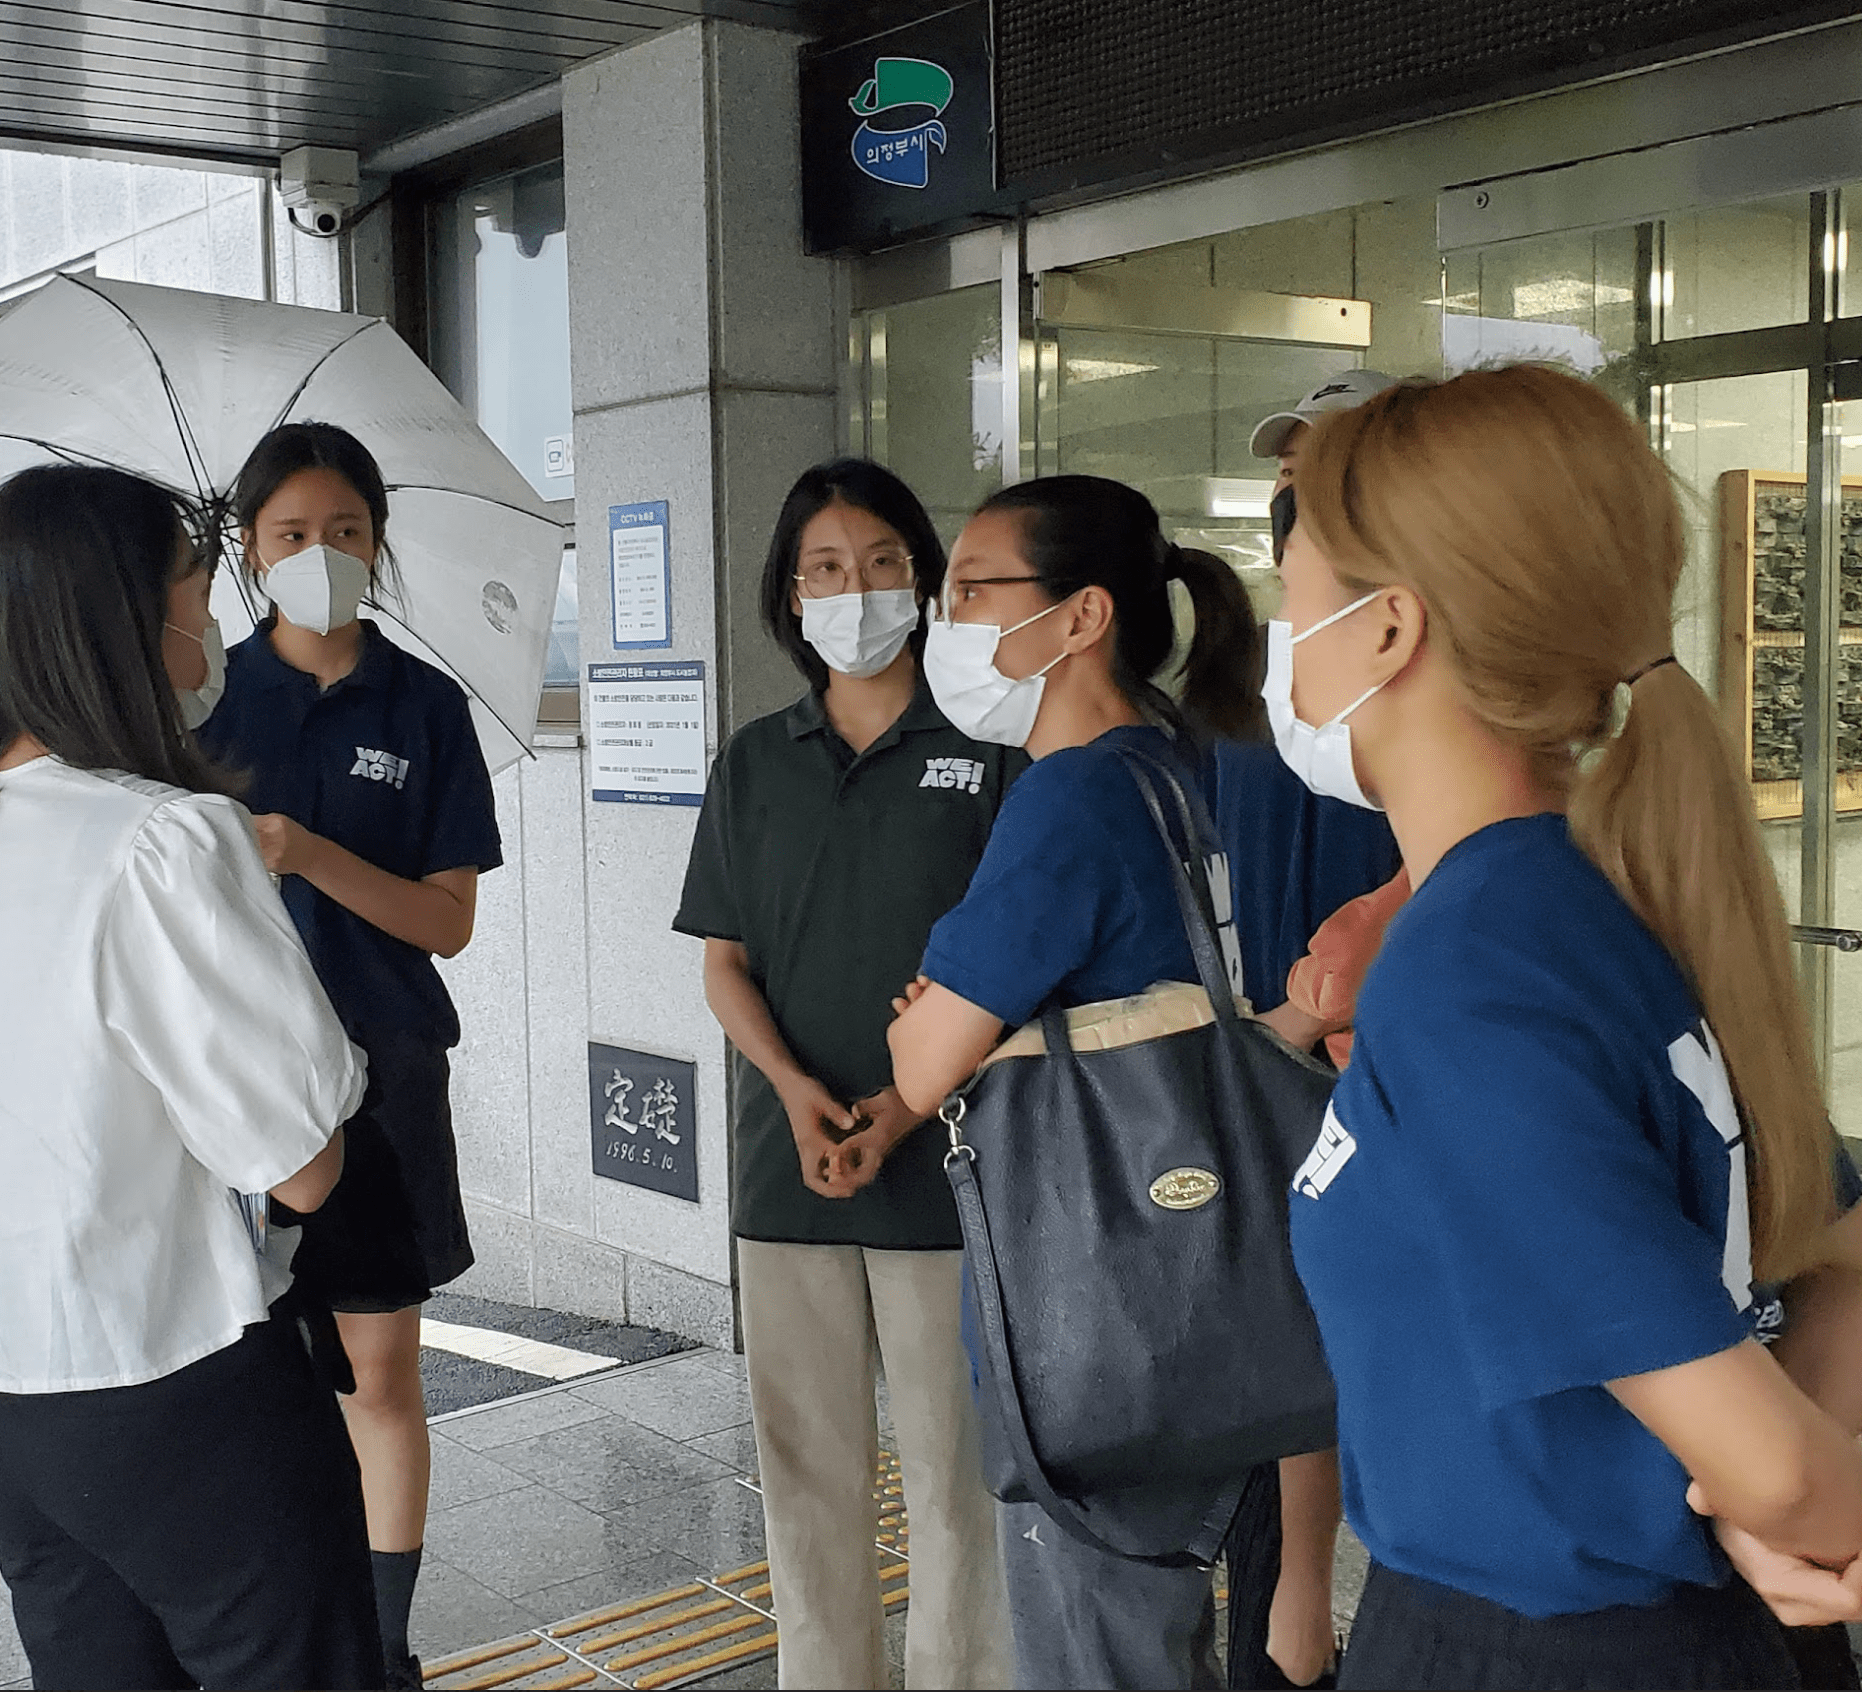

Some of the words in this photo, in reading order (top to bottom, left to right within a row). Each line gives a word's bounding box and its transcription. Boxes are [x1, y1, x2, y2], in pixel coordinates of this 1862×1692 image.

[866, 133, 923, 164] 의정부시
[355, 746, 401, 770] WE
[925, 757, 974, 772] WE
[349, 758, 409, 790] ACT!
[918, 762, 985, 795] ACT!
